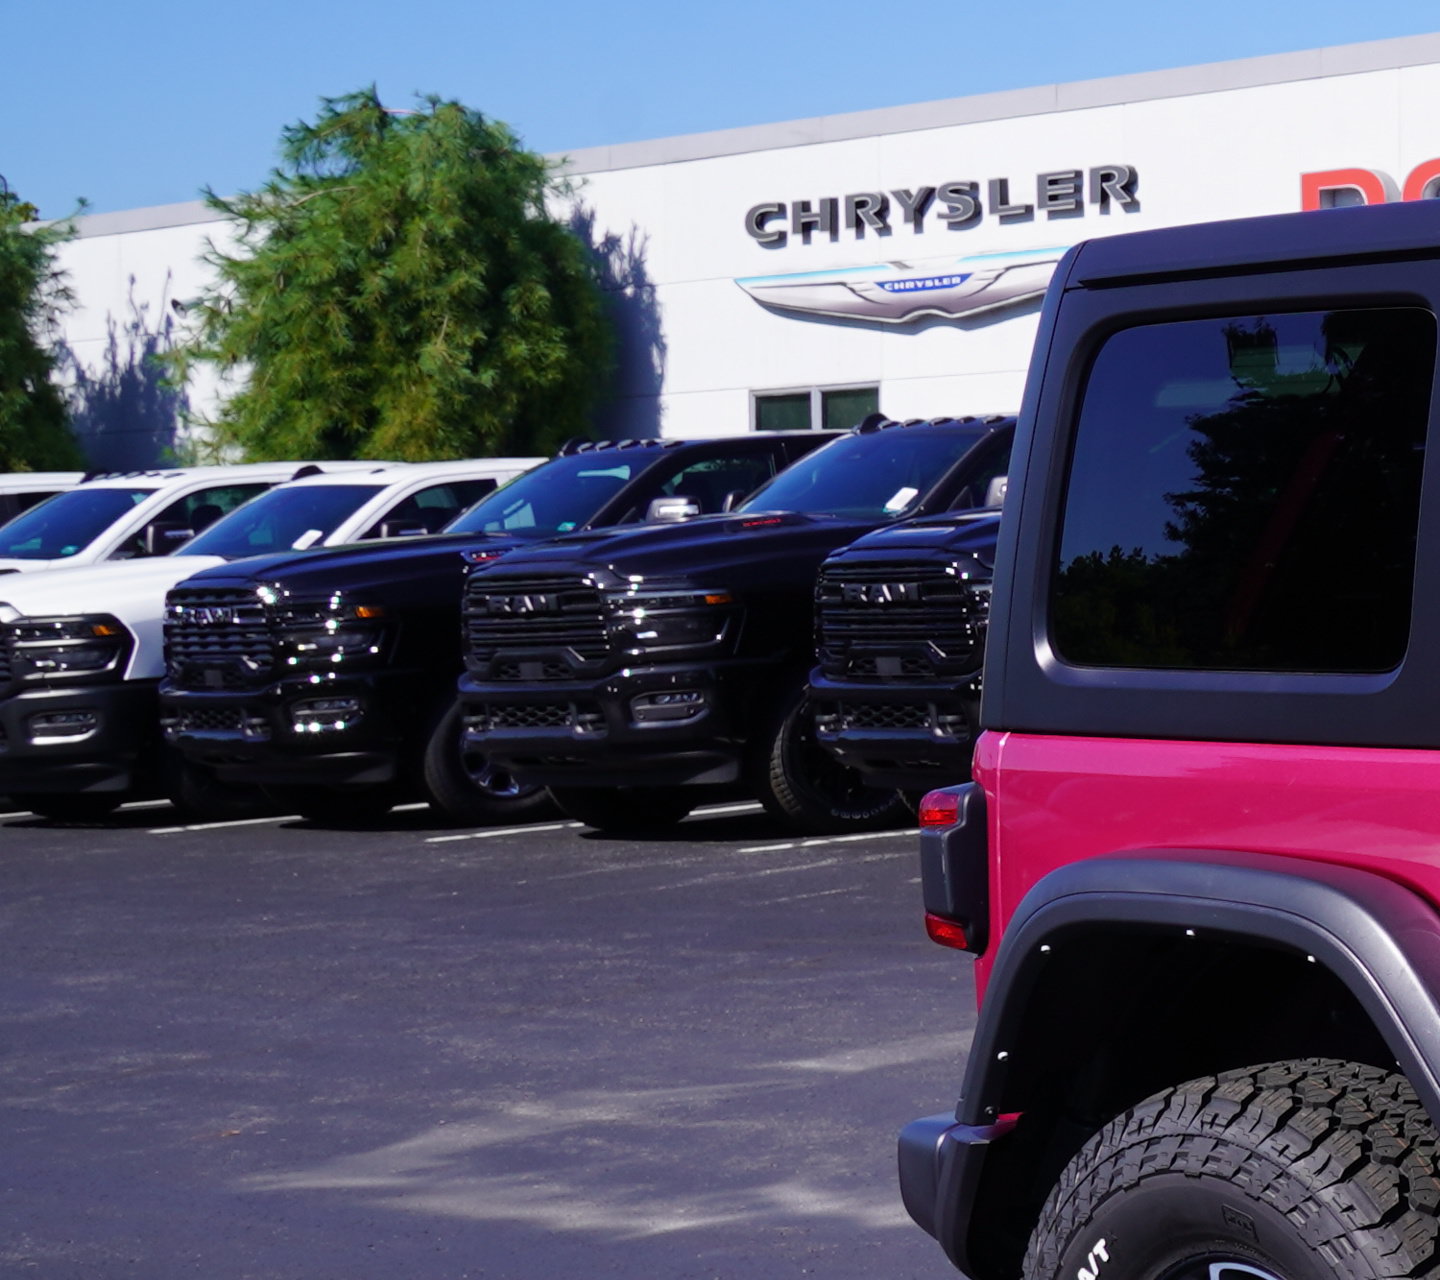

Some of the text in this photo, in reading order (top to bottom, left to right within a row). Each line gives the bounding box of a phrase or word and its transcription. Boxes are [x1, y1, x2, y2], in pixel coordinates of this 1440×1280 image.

[744, 164, 1141, 250] CHRYSLER
[883, 274, 962, 292] CHRYSLER
[842, 583, 919, 603] RAM
[487, 594, 559, 613] RAM
